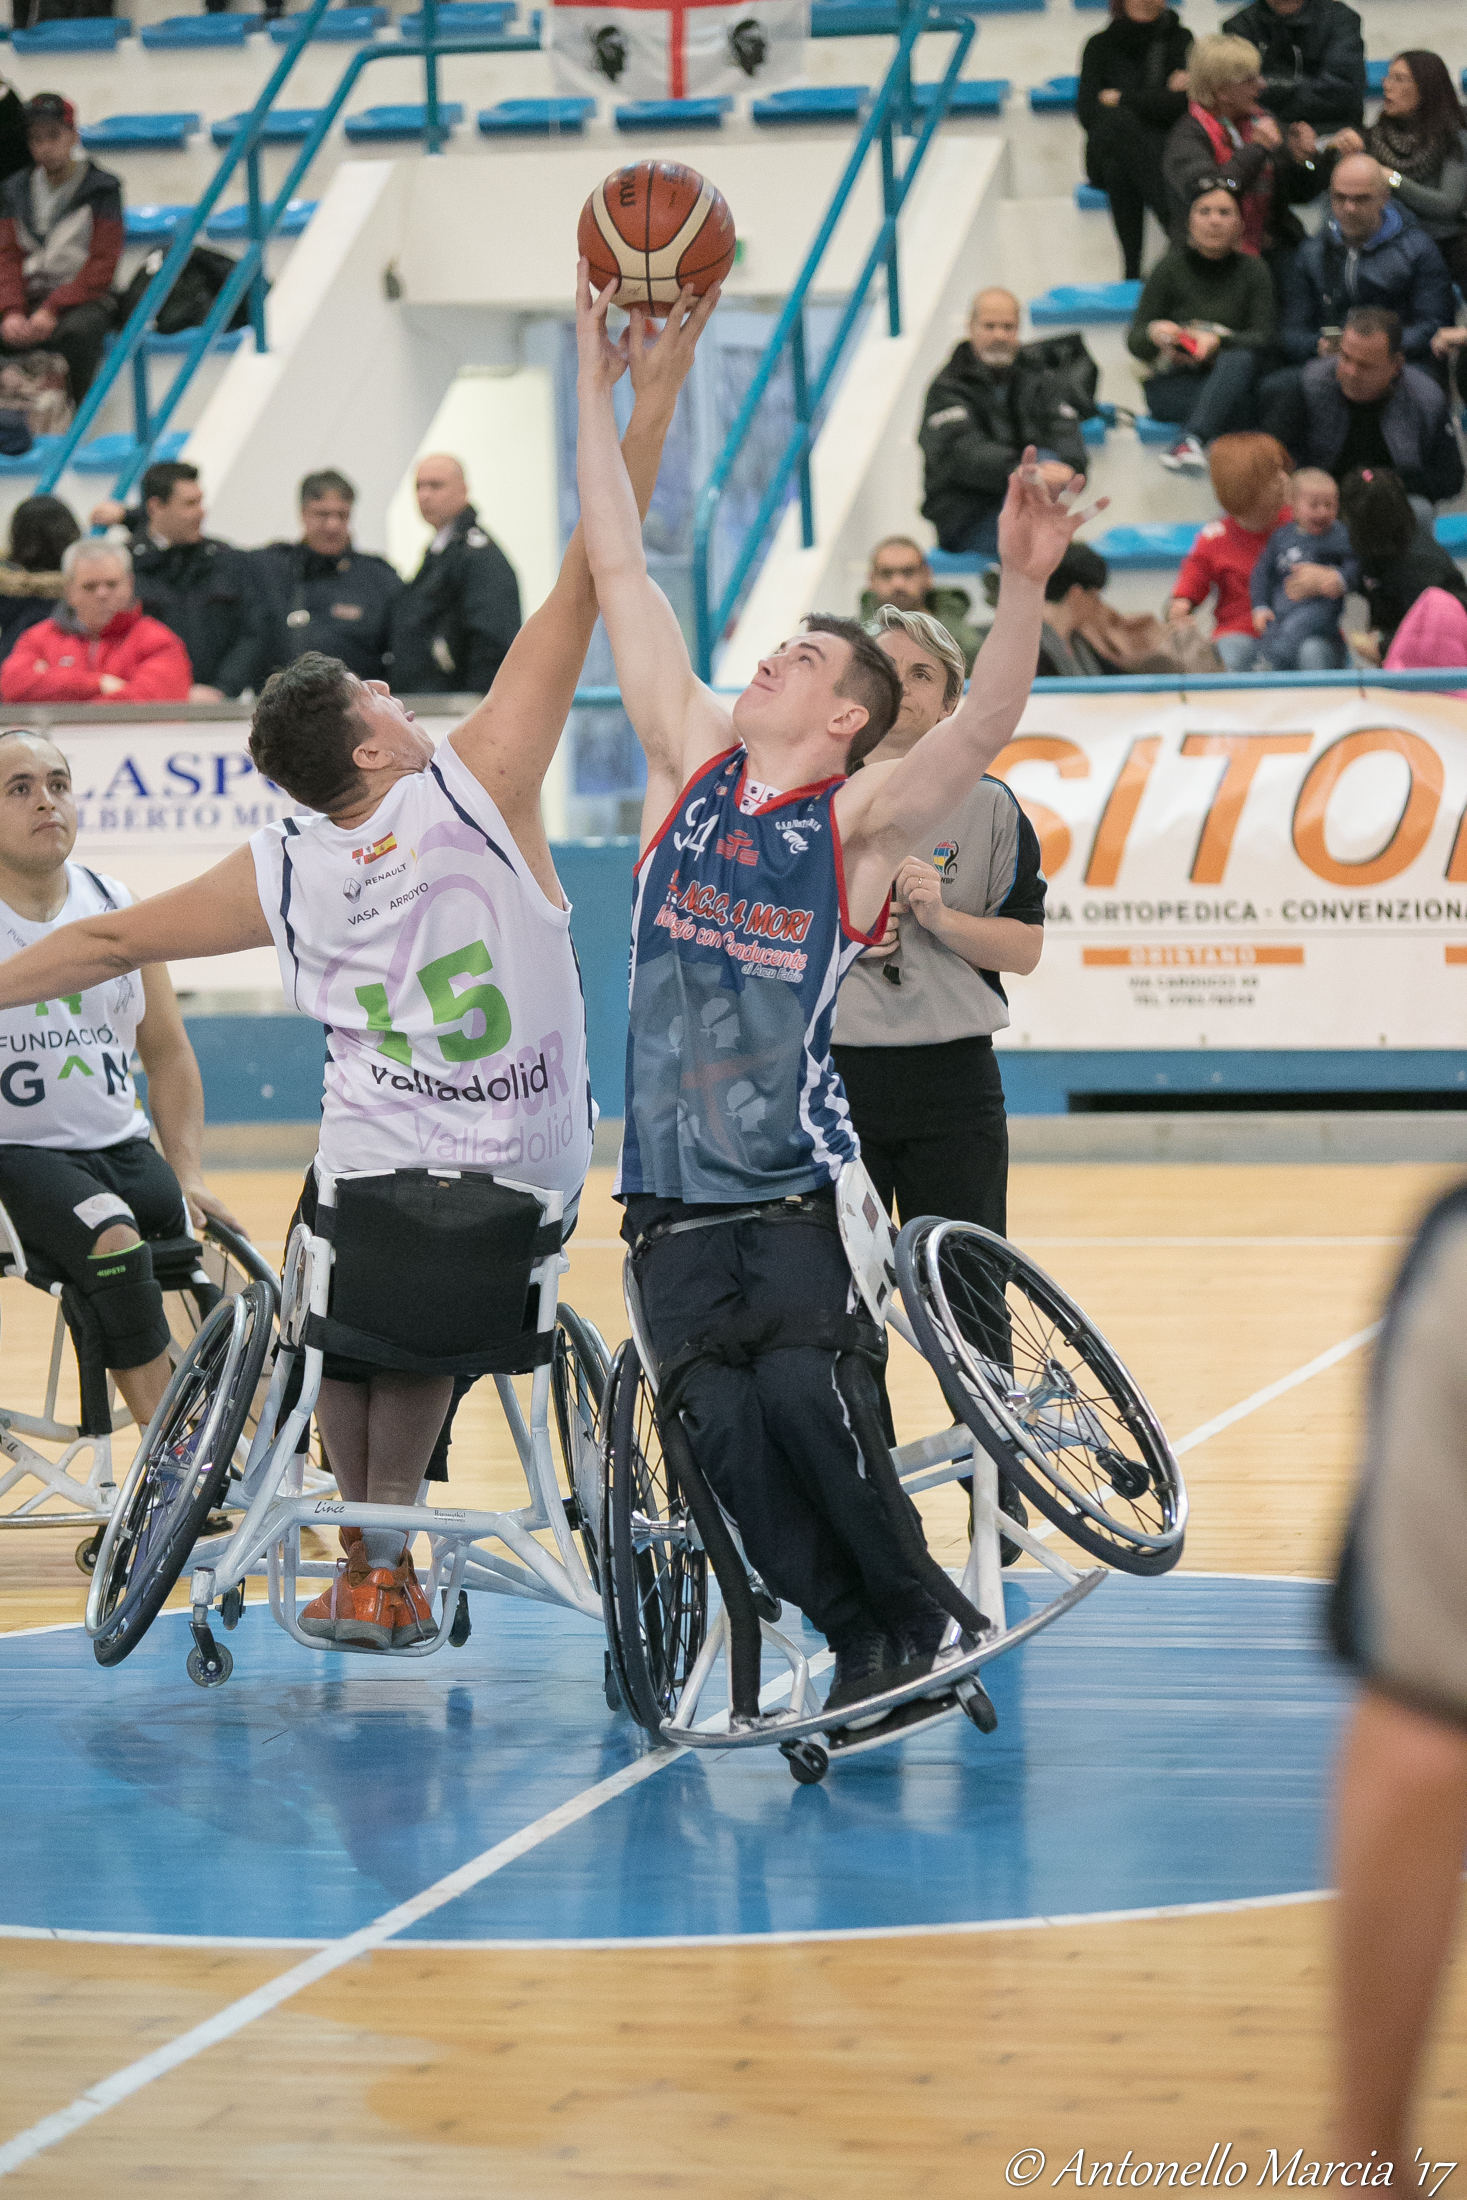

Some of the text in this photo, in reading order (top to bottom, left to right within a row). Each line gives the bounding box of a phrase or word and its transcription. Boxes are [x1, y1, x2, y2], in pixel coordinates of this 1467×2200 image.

[985, 724, 1467, 888] SITO
[365, 863, 407, 886] RENAULT
[347, 882, 429, 926] VASA ARROYO
[743, 901, 815, 943] MORI
[1082, 900, 1259, 923] ORTOPEDICA
[1281, 898, 1467, 923] CONVENZION
[696, 926, 724, 949] con
[741, 963, 753, 975] di
[776, 966, 804, 984] Fabio
[354, 938, 513, 1067] 15
[371, 1052, 549, 1103] Valladolid
[413, 1099, 574, 1164] Valladolid
[314, 1501, 346, 1514] Lince
